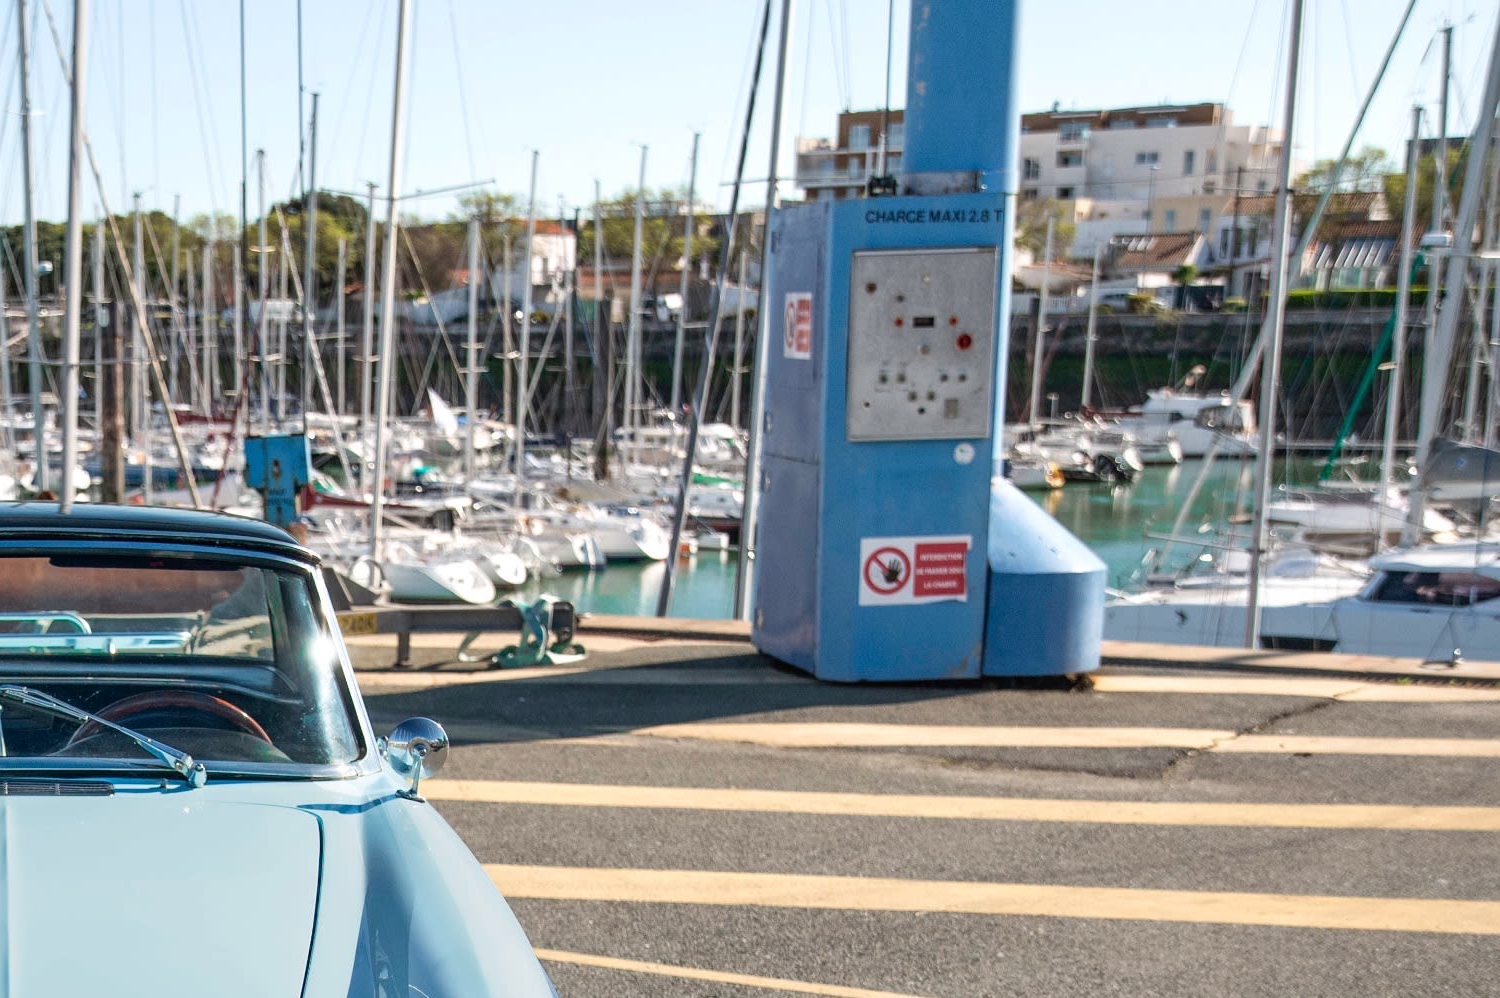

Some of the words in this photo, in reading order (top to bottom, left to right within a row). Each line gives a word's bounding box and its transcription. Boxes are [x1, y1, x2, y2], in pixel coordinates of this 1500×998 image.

[929, 209, 965, 223] MAXI
[968, 209, 990, 223] 2.8
[994, 209, 1004, 223] T
